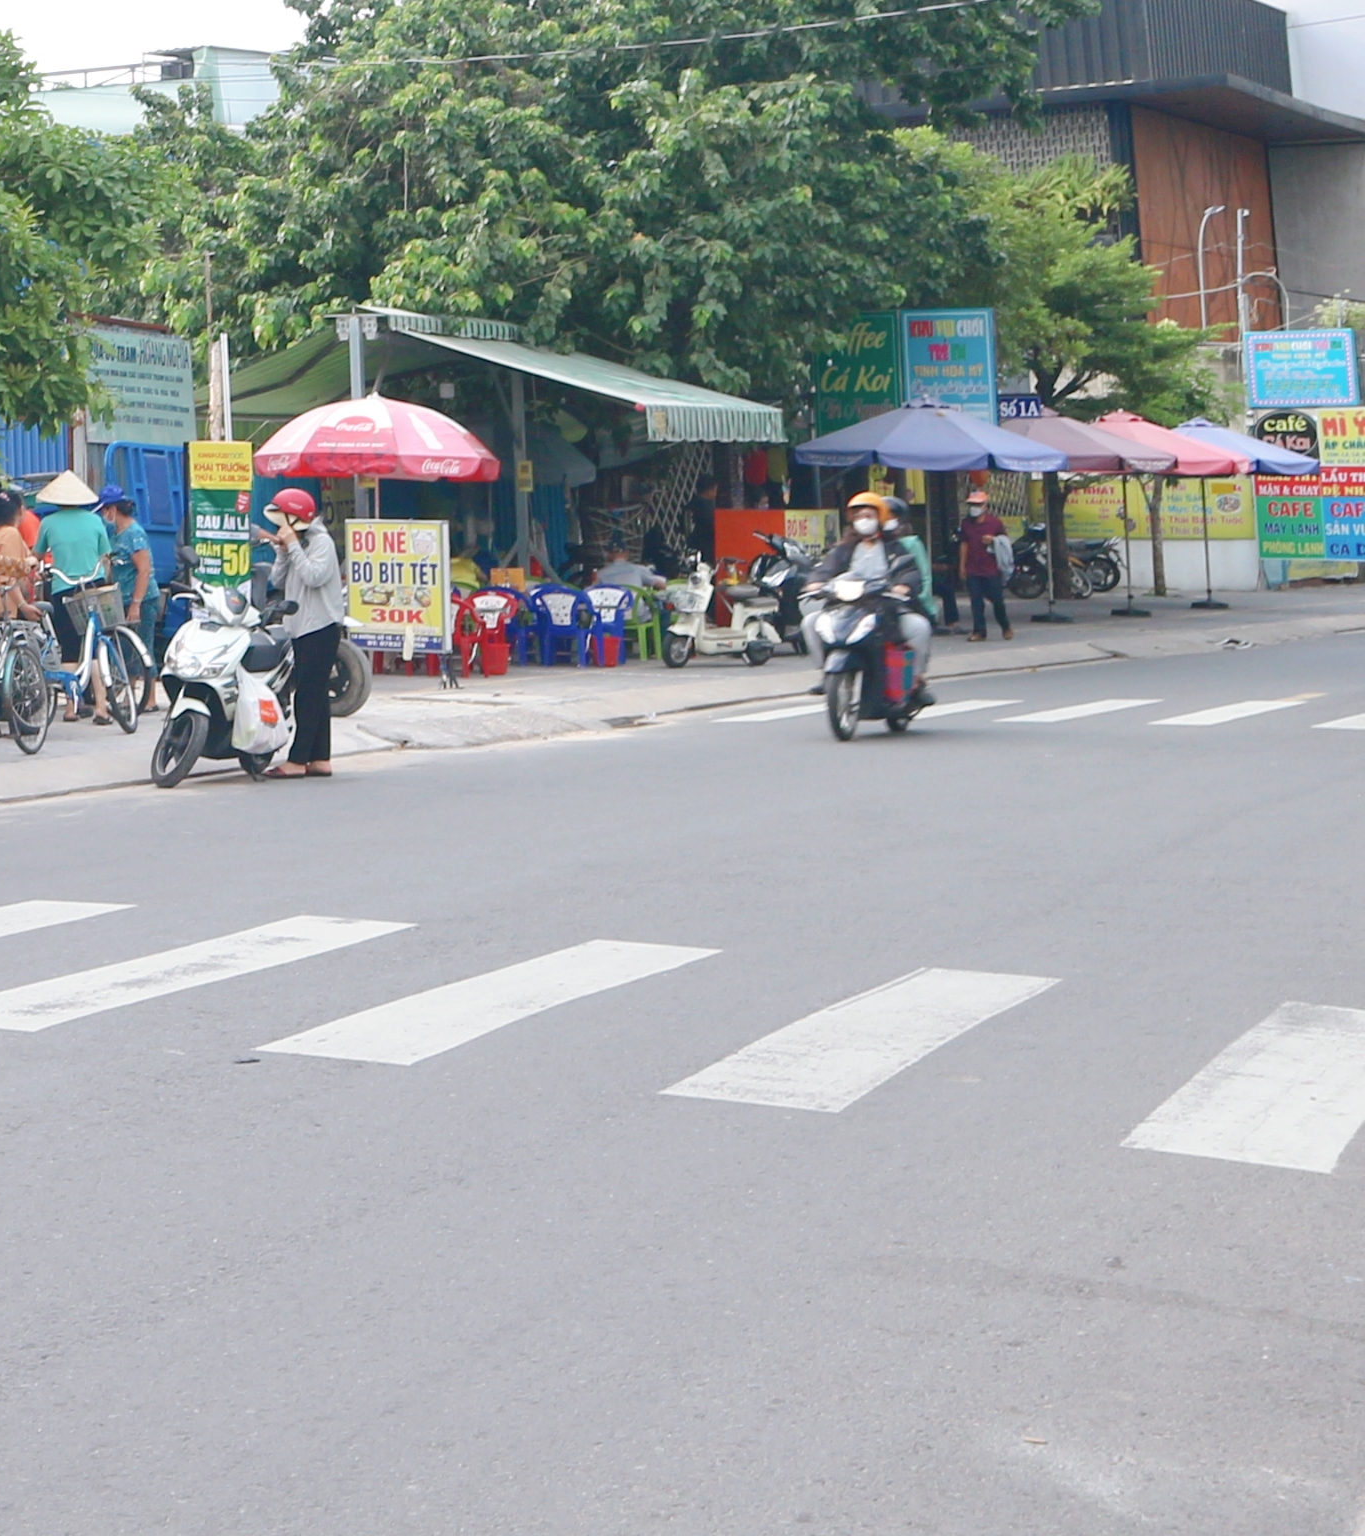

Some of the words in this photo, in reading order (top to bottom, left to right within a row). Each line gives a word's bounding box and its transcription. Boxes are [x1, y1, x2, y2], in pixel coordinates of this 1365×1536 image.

[847, 321, 888, 357] ffee
[821, 366, 849, 393] Cá
[854, 365, 894, 393] Koi
[999, 398, 1017, 417] Số
[1018, 401, 1041, 417] 1A
[1264, 415, 1307, 432] café
[1322, 411, 1347, 437] MÌ
[194, 463, 213, 472] KHAI
[1292, 485, 1319, 496] CHAY
[1268, 500, 1315, 518] CAFE
[196, 514, 220, 530] RAU
[237, 513, 250, 531] LÁ
[1265, 520, 1287, 534] MÁY
[1325, 520, 1350, 536] SÂN
[352, 525, 376, 553] BÒ
[383, 526, 406, 554] NÉ
[195, 541, 221, 558] GIẢM
[223, 542, 250, 577] 50
[352, 556, 373, 583] BÒ
[380, 557, 404, 584] BÍT
[410, 555, 438, 585] TẾT
[371, 608, 424, 624] 30K
